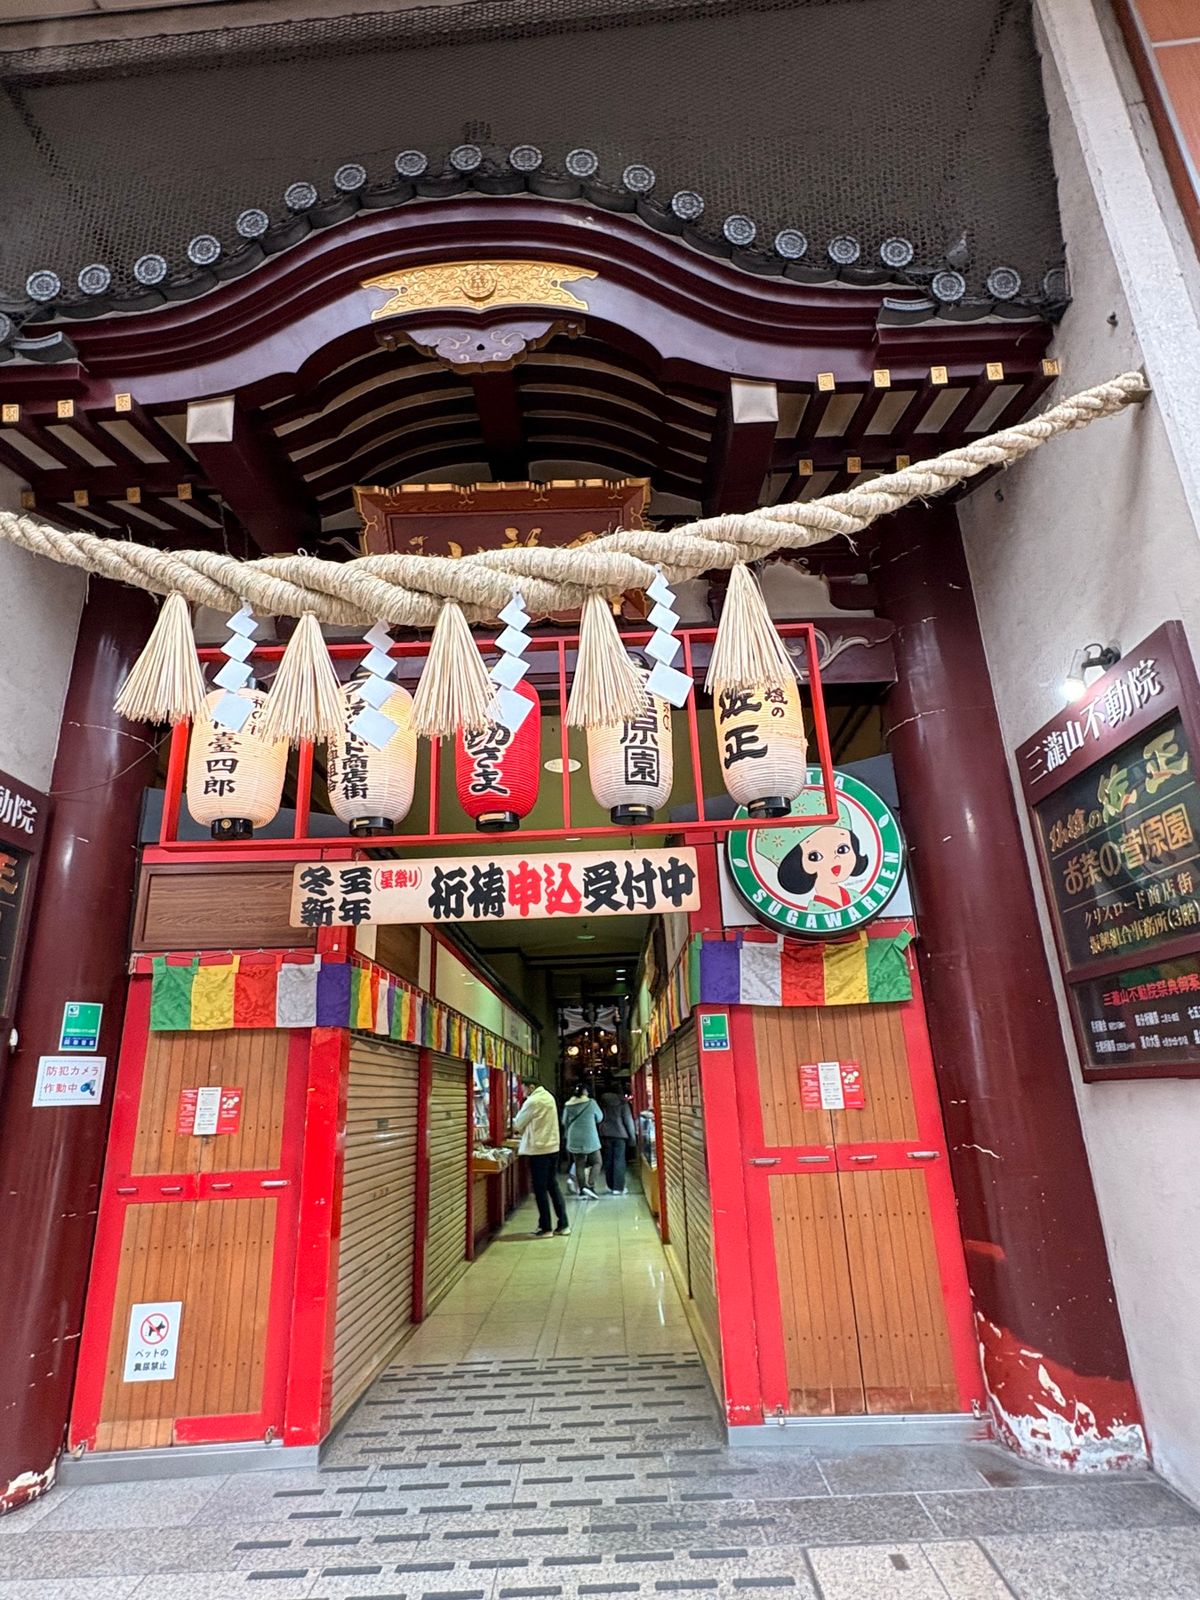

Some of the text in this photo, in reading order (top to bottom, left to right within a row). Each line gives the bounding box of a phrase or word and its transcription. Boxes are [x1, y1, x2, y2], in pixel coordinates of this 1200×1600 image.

[719, 686, 768, 769] 佐正
[1026, 659, 1163, 786] 三瀧山不動院
[203, 718, 242, 797] 臺四郎
[806, 771, 845, 790] TA
[1063, 803, 1193, 895] お茶の菅原園
[300, 866, 372, 896] 冬至
[752, 851, 899, 929] SUGAWARAEN
[1084, 871, 1194, 929] クリスロード商店街
[300, 897, 372, 926] 新年
[1102, 973, 1200, 1006] 三瀧山不動院祭典御案
[44, 1083, 77, 1093] 作動中
[46, 1066, 99, 1077] 防犯カメラ
